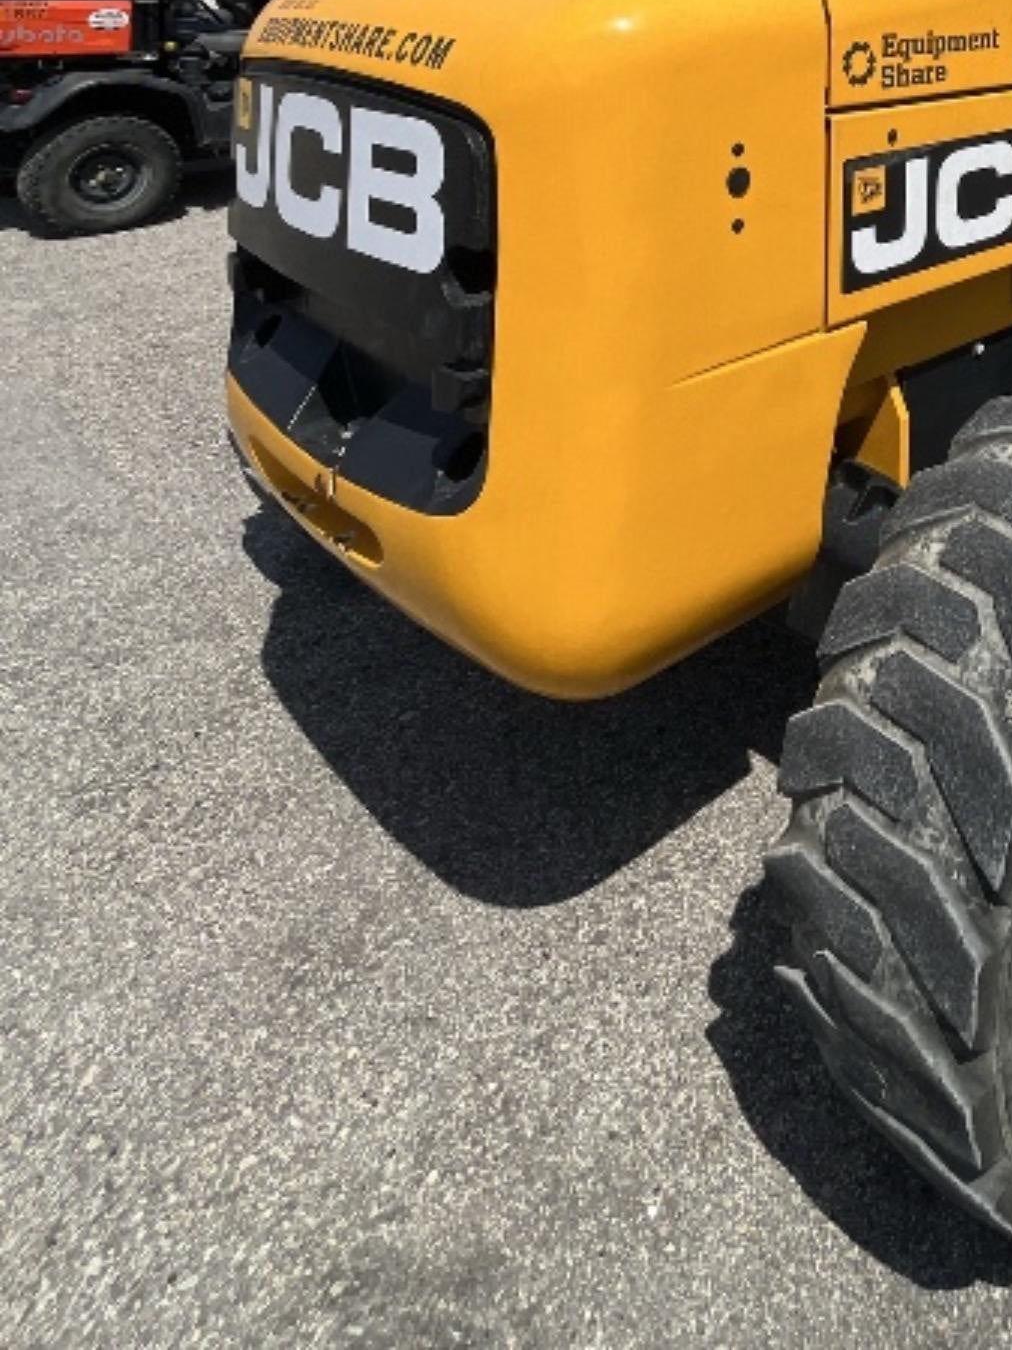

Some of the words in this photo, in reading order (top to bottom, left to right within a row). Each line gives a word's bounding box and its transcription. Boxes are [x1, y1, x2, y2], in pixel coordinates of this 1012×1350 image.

[0, 23, 85, 44] ubota
[881, 27, 1001, 62] Equipment
[881, 62, 947, 89] Share
[236, 82, 445, 274] JCB
